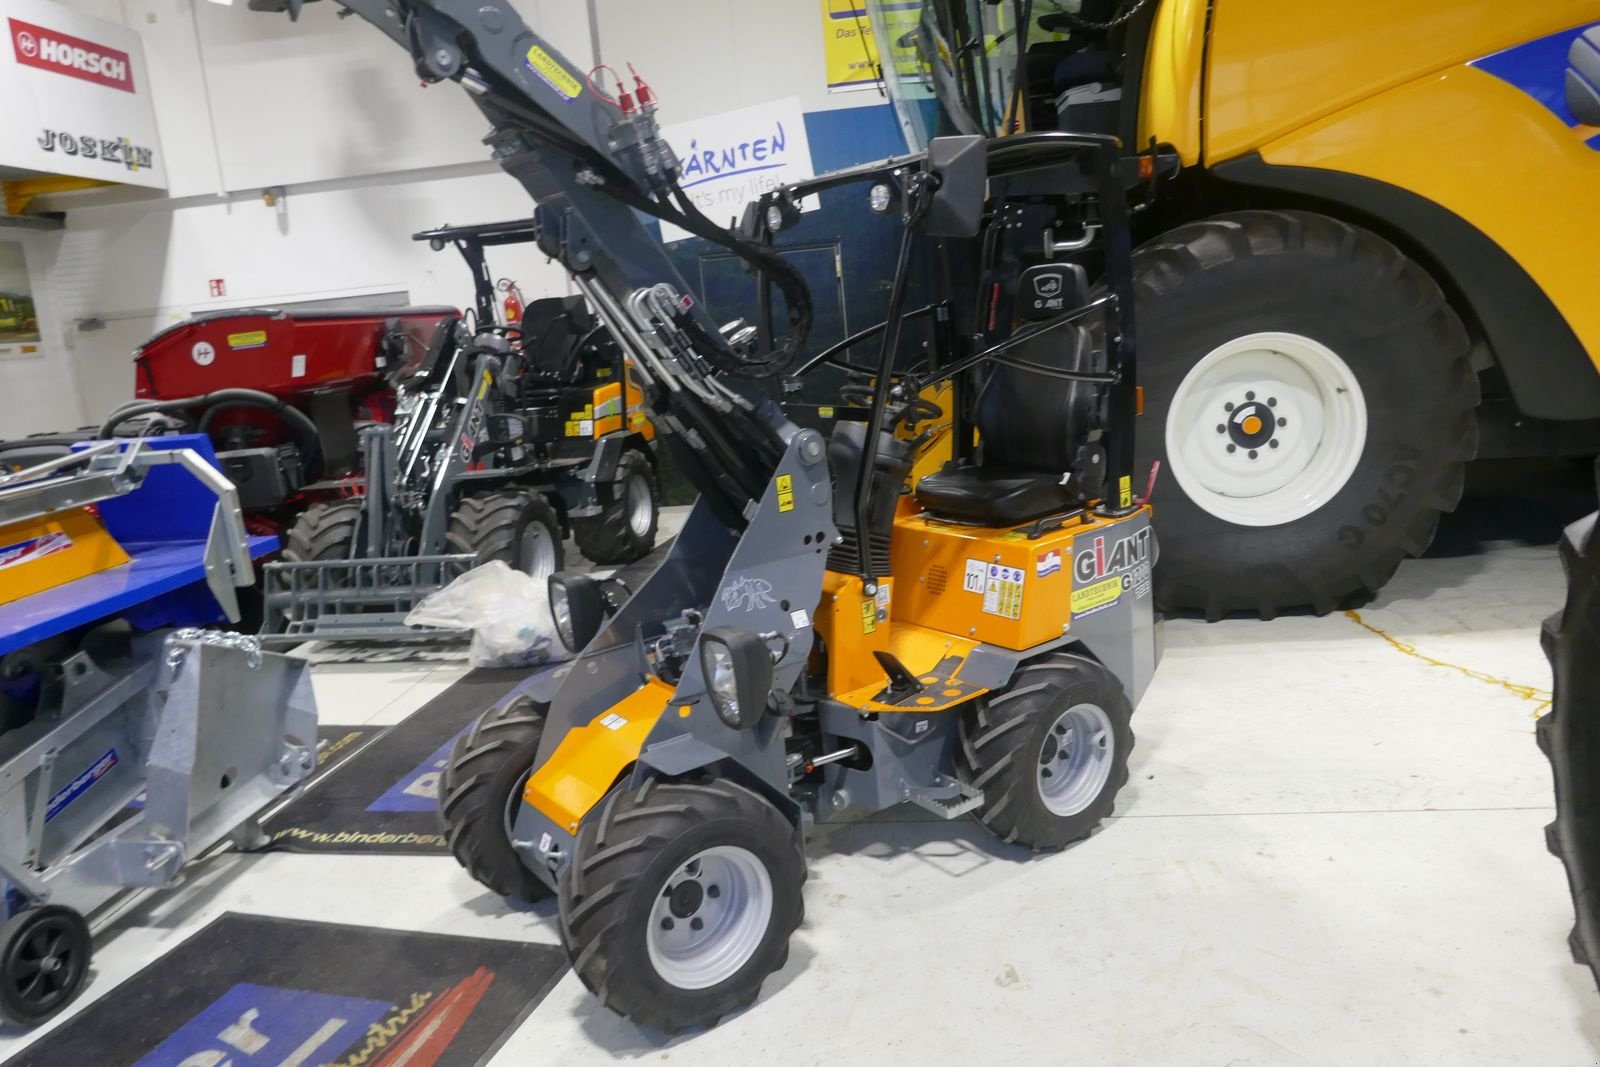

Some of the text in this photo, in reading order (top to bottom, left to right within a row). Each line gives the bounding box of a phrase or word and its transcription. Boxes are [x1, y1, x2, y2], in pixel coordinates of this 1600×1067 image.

[836, 28, 857, 38] Das
[39, 38, 126, 81] HORSCH
[37, 129, 152, 171] JOSKIN
[718, 186, 744, 206] my
[273, 827, 448, 847] www.binderberg
